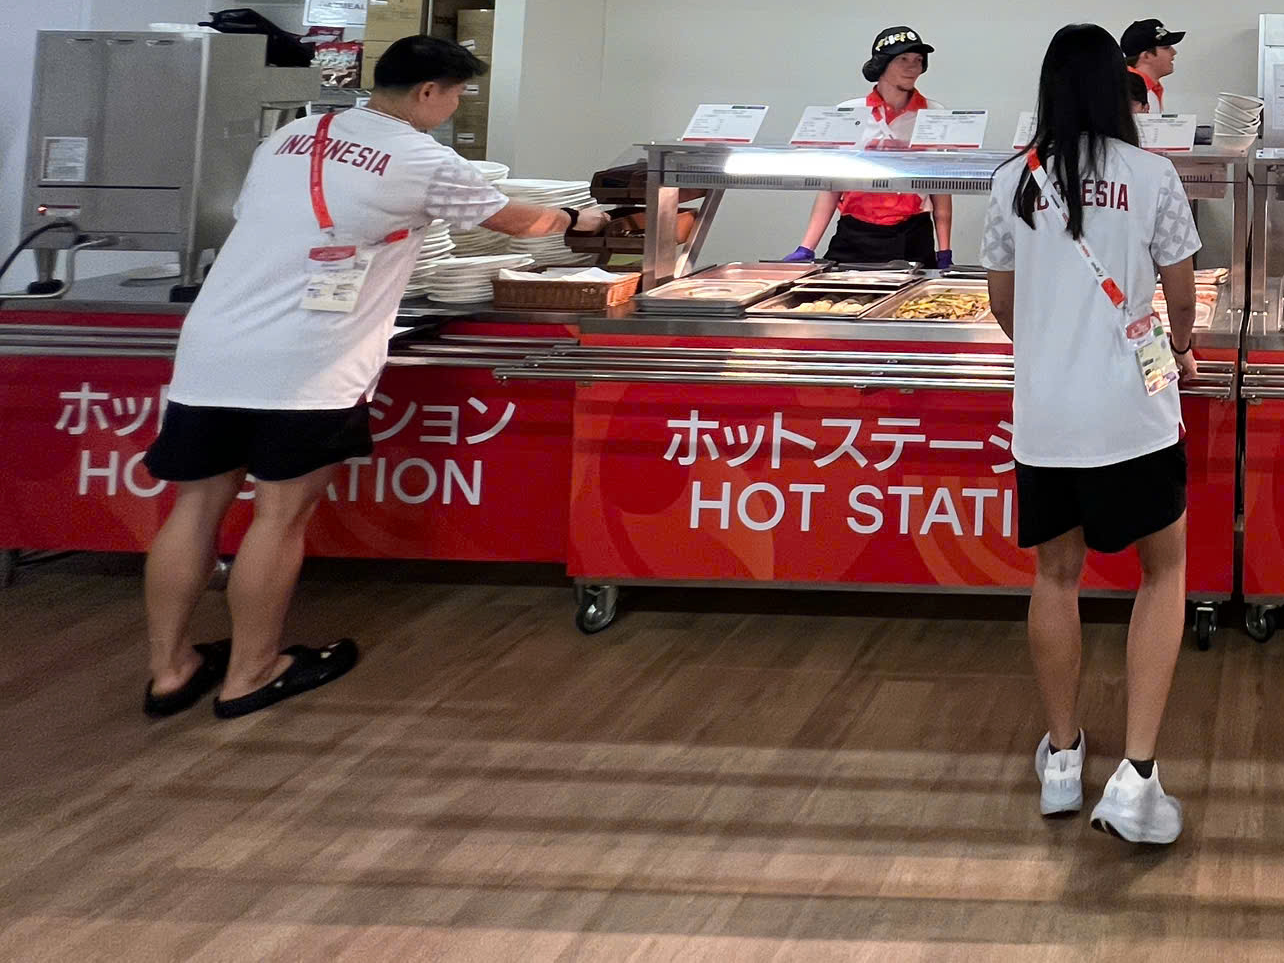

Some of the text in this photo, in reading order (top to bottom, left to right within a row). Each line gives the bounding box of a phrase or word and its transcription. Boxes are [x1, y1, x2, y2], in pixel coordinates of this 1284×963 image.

[273, 133, 393, 177] INDNESIA
[78, 449, 169, 498] HO
[689, 480, 1014, 538] HOT STATI
